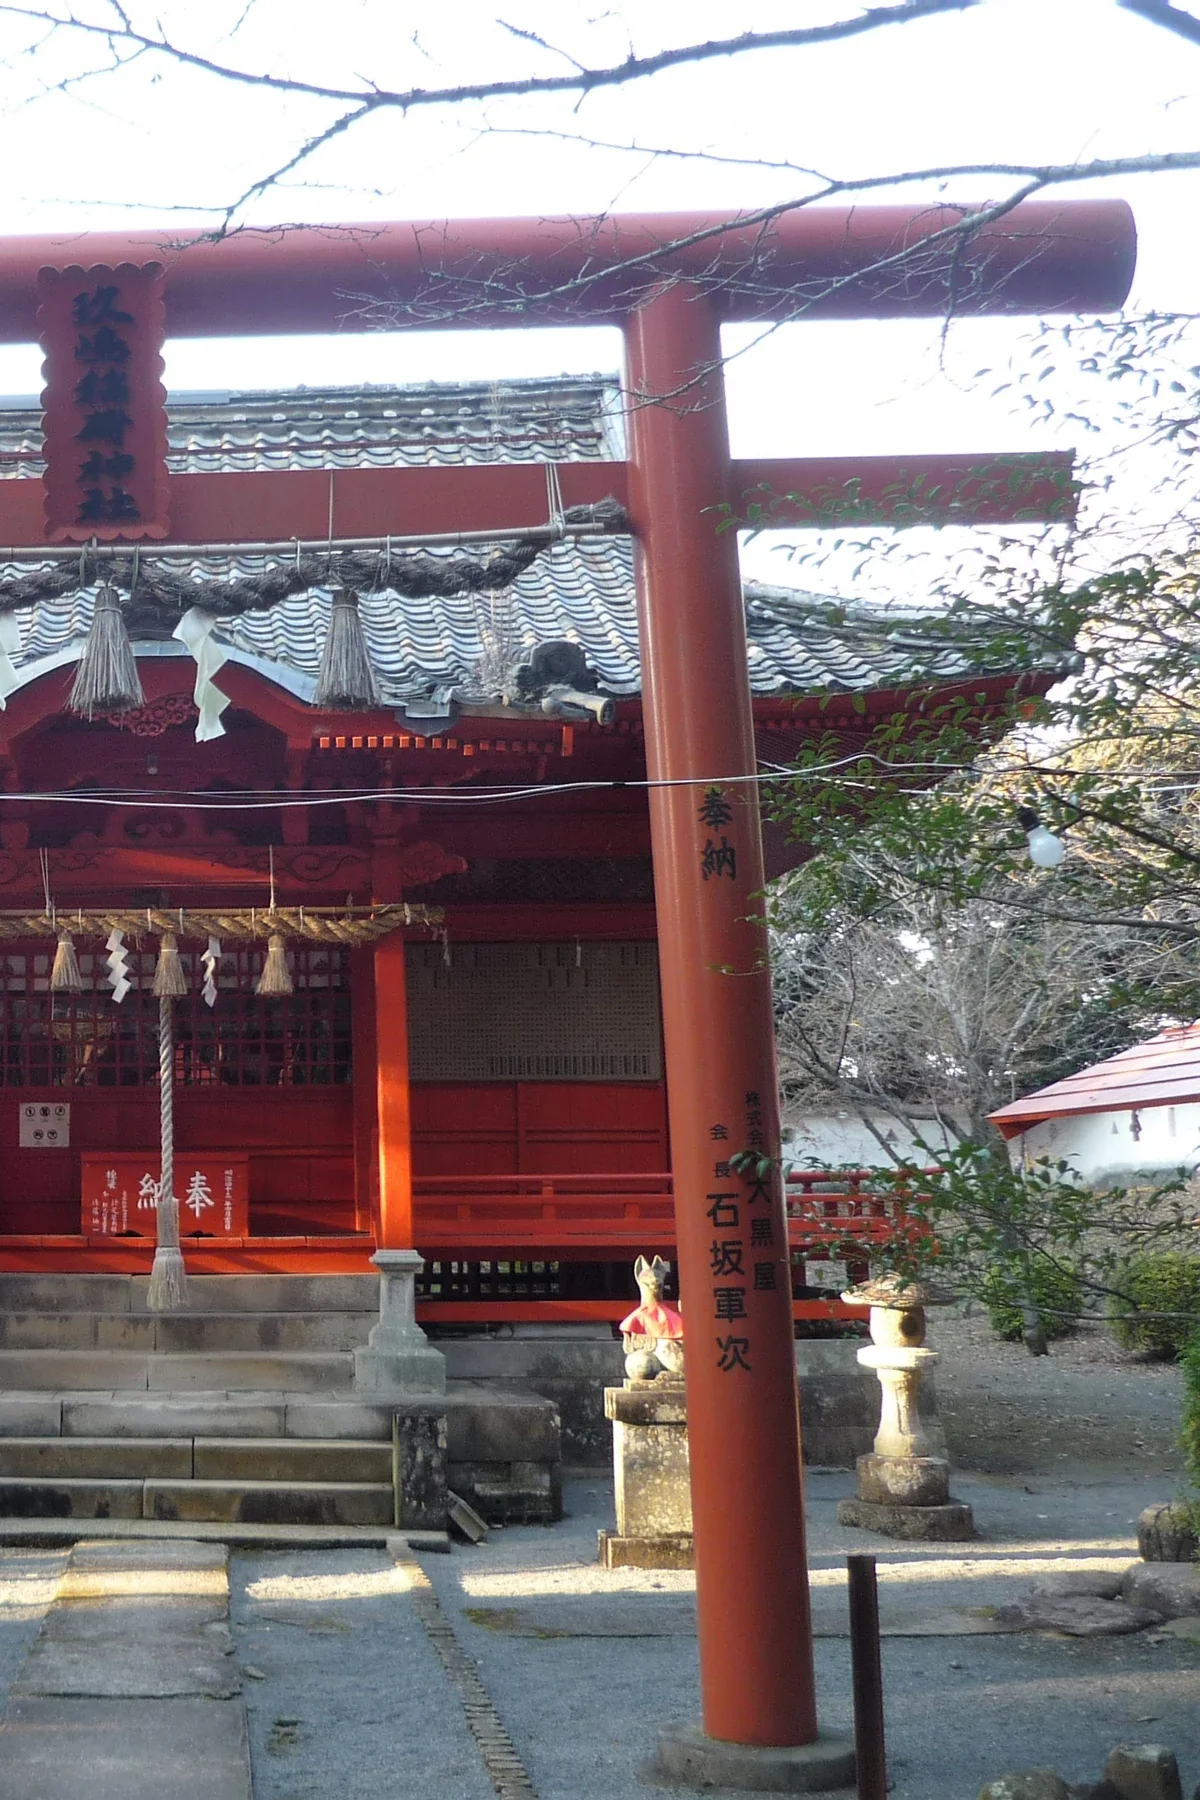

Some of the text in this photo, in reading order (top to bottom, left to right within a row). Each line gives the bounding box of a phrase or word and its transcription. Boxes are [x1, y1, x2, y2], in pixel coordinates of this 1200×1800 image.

[697, 787, 737, 882] 奉納
[745, 1091, 777, 1291] 株式会大黒屋
